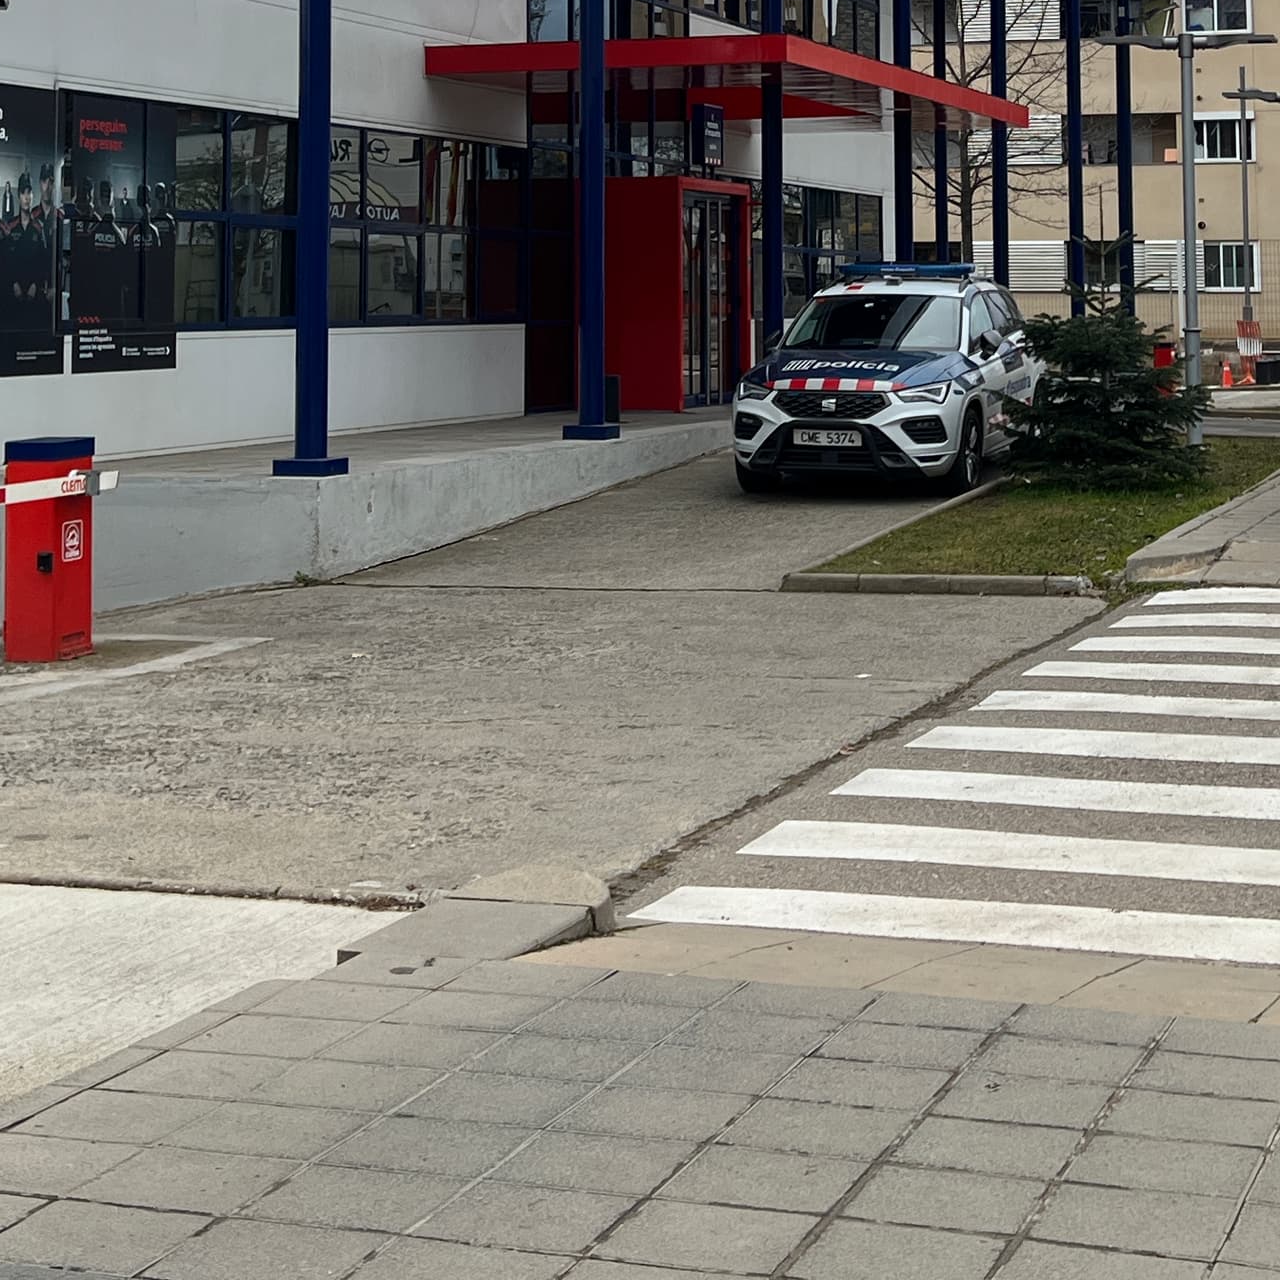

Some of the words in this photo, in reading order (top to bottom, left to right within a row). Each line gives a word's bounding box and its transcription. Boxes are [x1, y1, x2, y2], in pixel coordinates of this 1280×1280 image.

[812, 360, 900, 372] policia
[800, 431, 821, 443] CME
[826, 432, 855, 445] 5374
